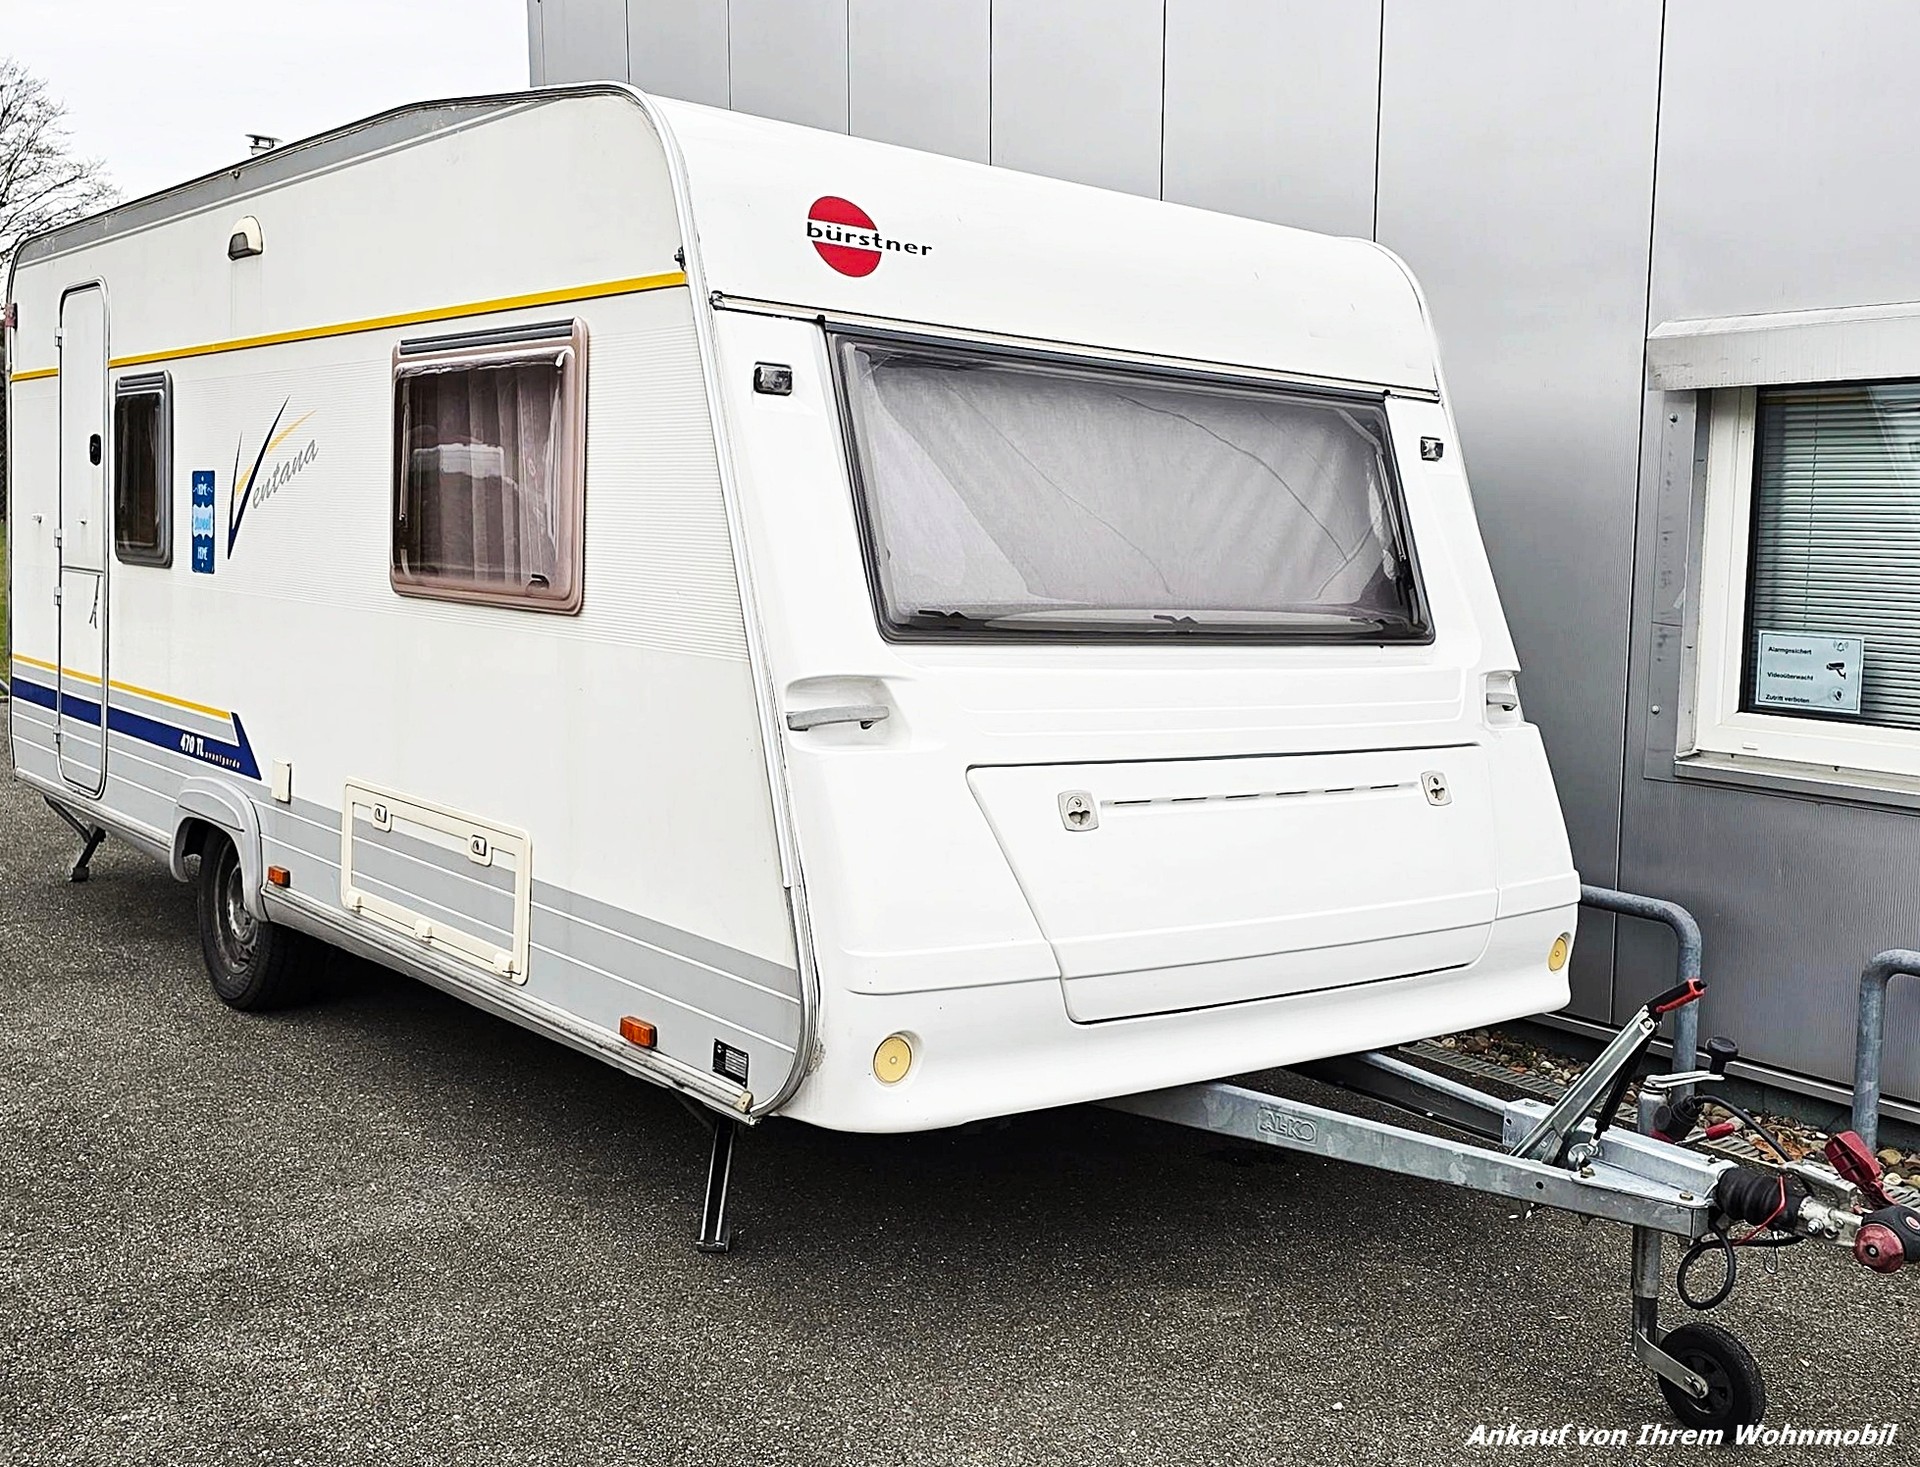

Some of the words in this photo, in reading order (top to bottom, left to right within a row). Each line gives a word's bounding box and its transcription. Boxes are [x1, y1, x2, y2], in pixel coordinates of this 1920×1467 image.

[806, 221, 932, 256] bürstner
[227, 394, 319, 560] Ventana
[1767, 672, 1813, 680] Videoüberwacht
[180, 733, 195, 753] 470
[196, 737, 205, 757] TL
